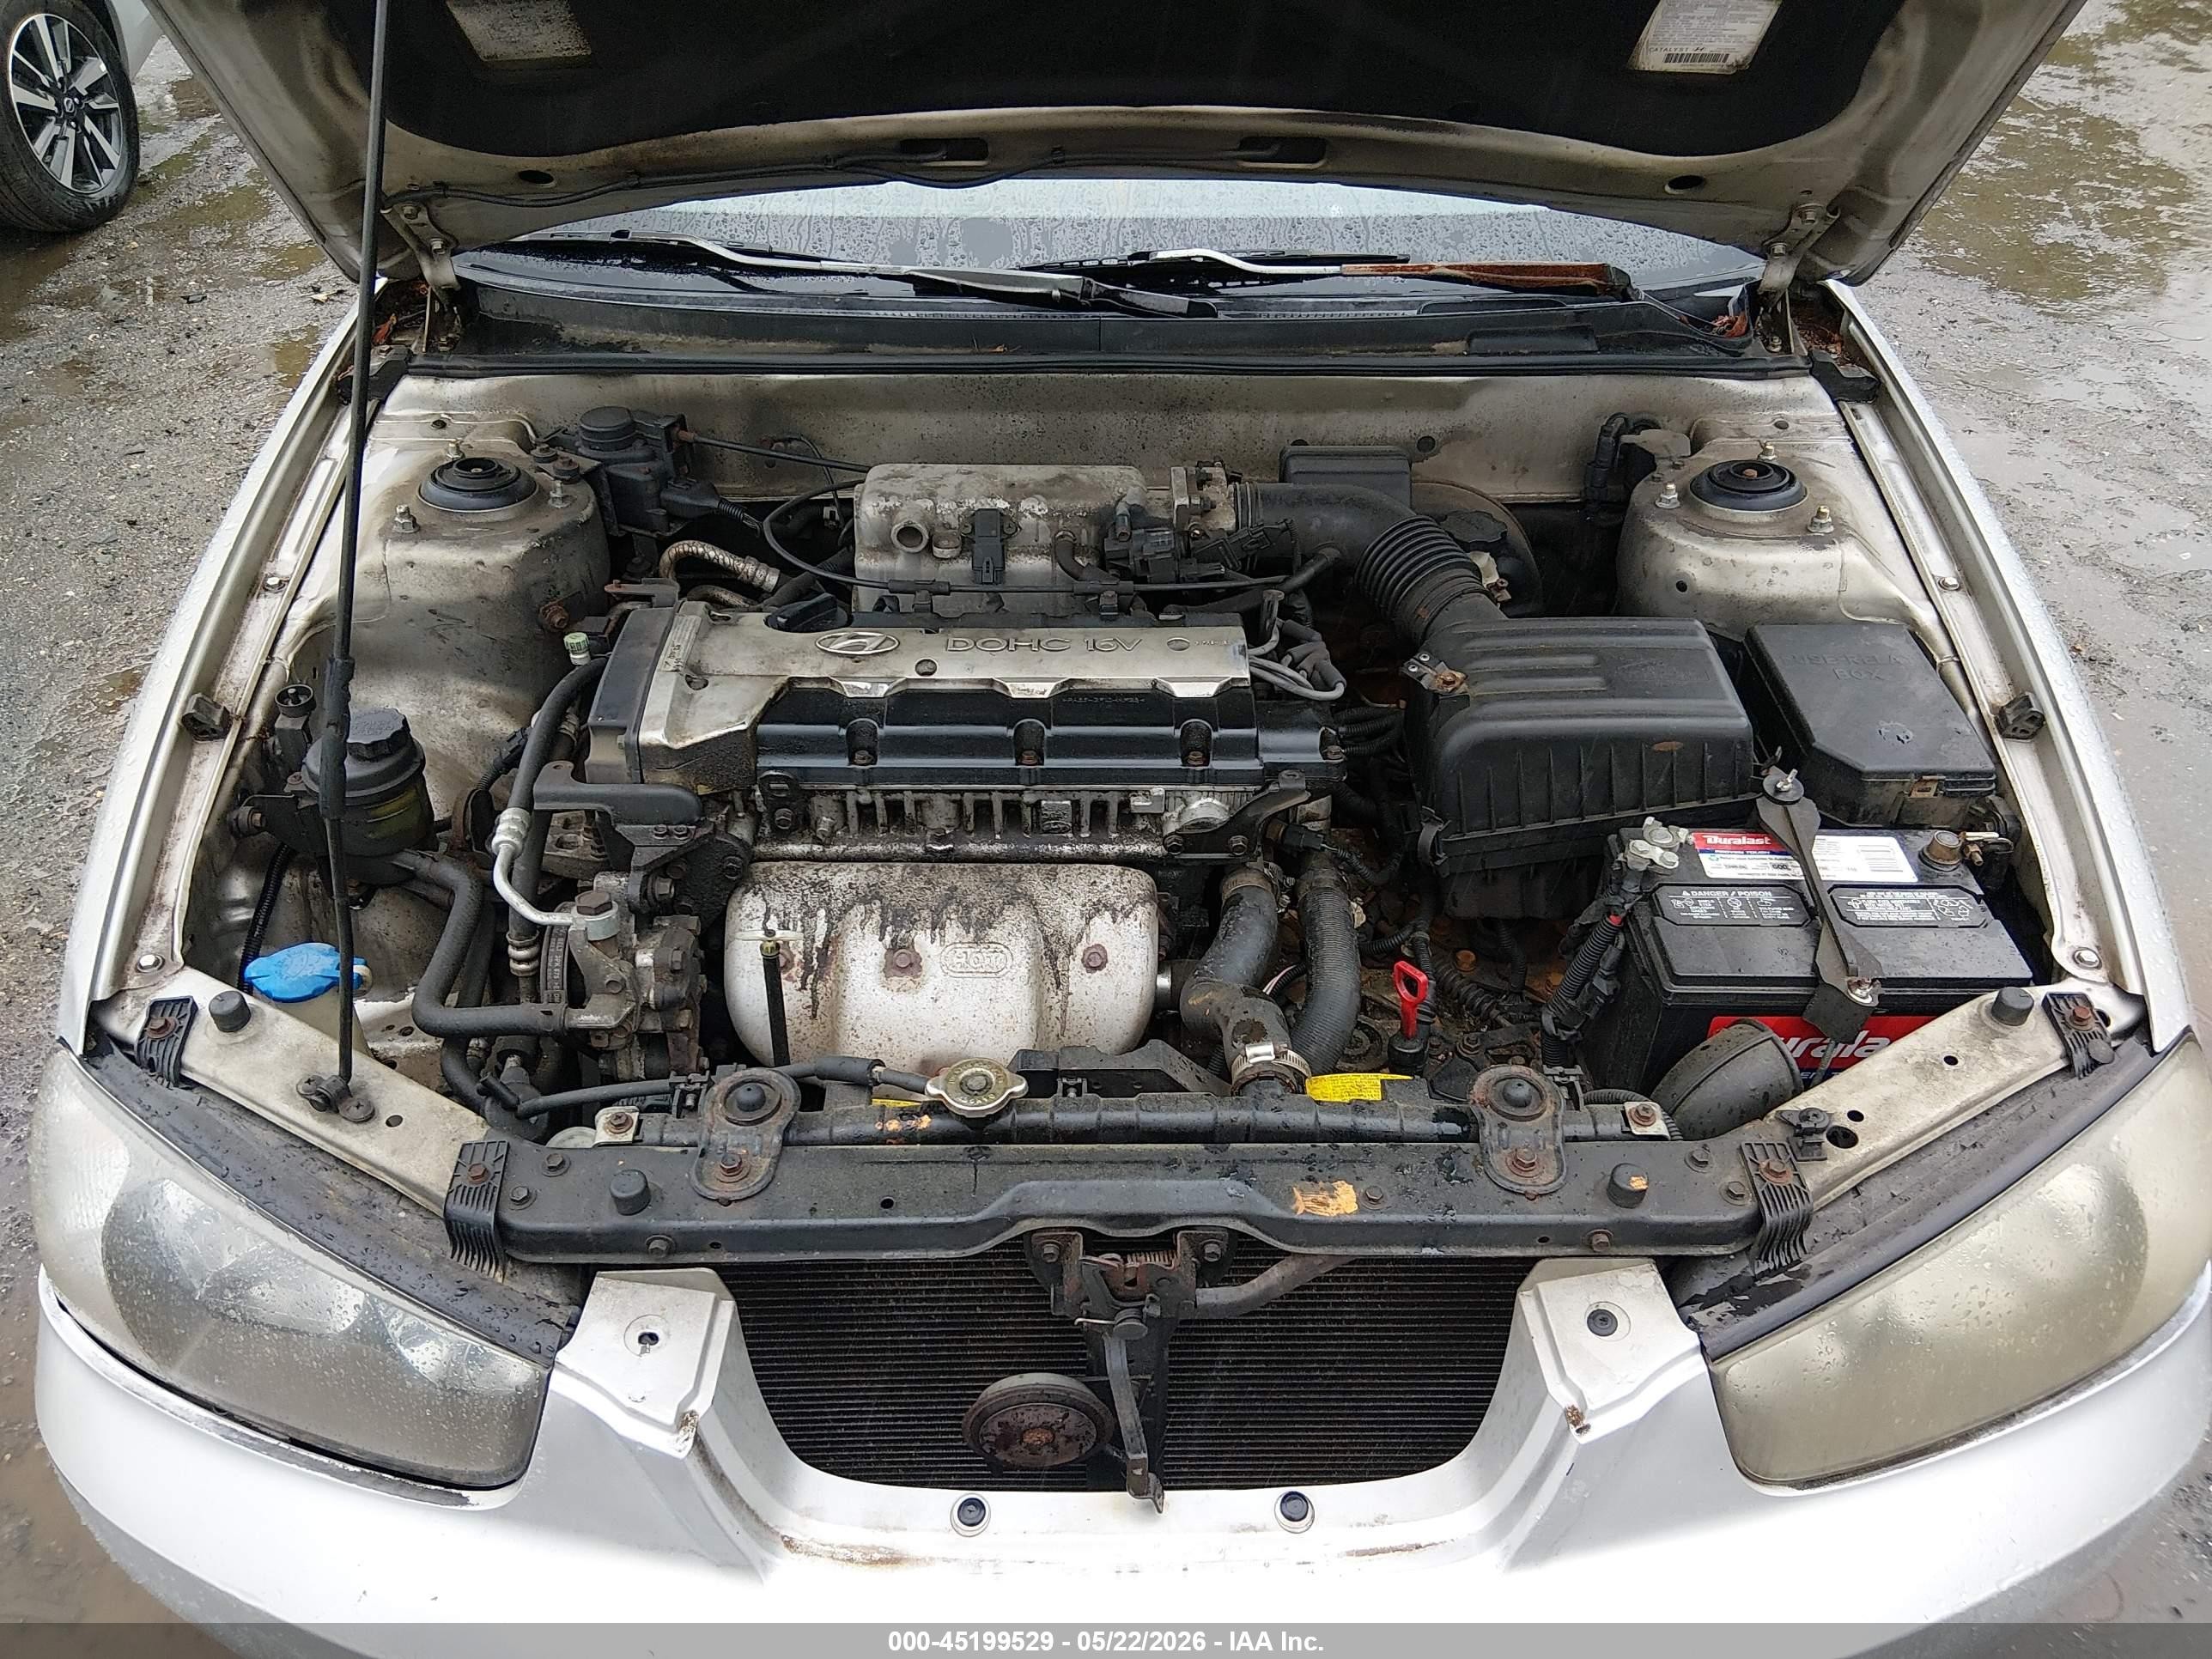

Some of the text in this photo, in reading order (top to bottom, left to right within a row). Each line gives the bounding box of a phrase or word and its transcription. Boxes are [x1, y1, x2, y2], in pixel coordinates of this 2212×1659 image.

[946, 637, 1143, 653] DOHC 16V
[1702, 835, 1771, 845] Duralast
